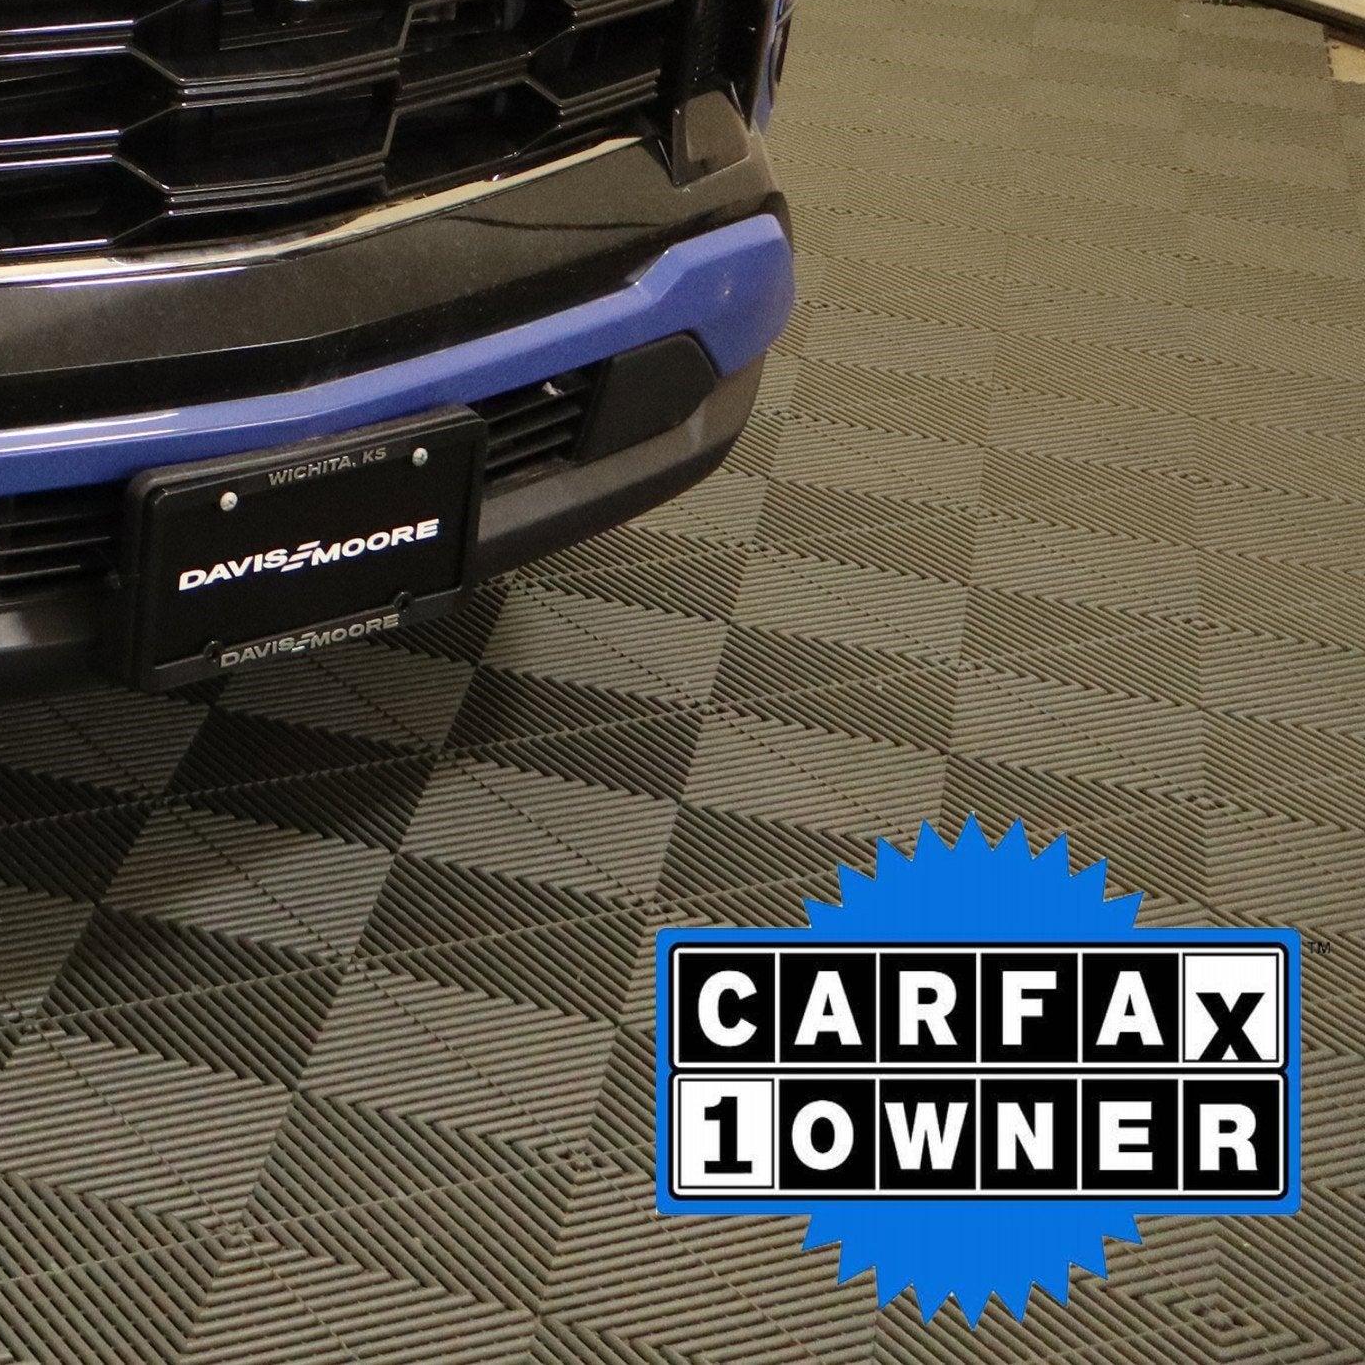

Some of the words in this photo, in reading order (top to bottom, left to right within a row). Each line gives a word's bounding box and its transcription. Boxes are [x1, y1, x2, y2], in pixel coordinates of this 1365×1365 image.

[362, 446, 388, 464] KS
[179, 549, 288, 591] DAVIS
[311, 518, 440, 566] MOORE
[220, 637, 295, 668] DAVIS
[310, 613, 400, 649] MOORE
